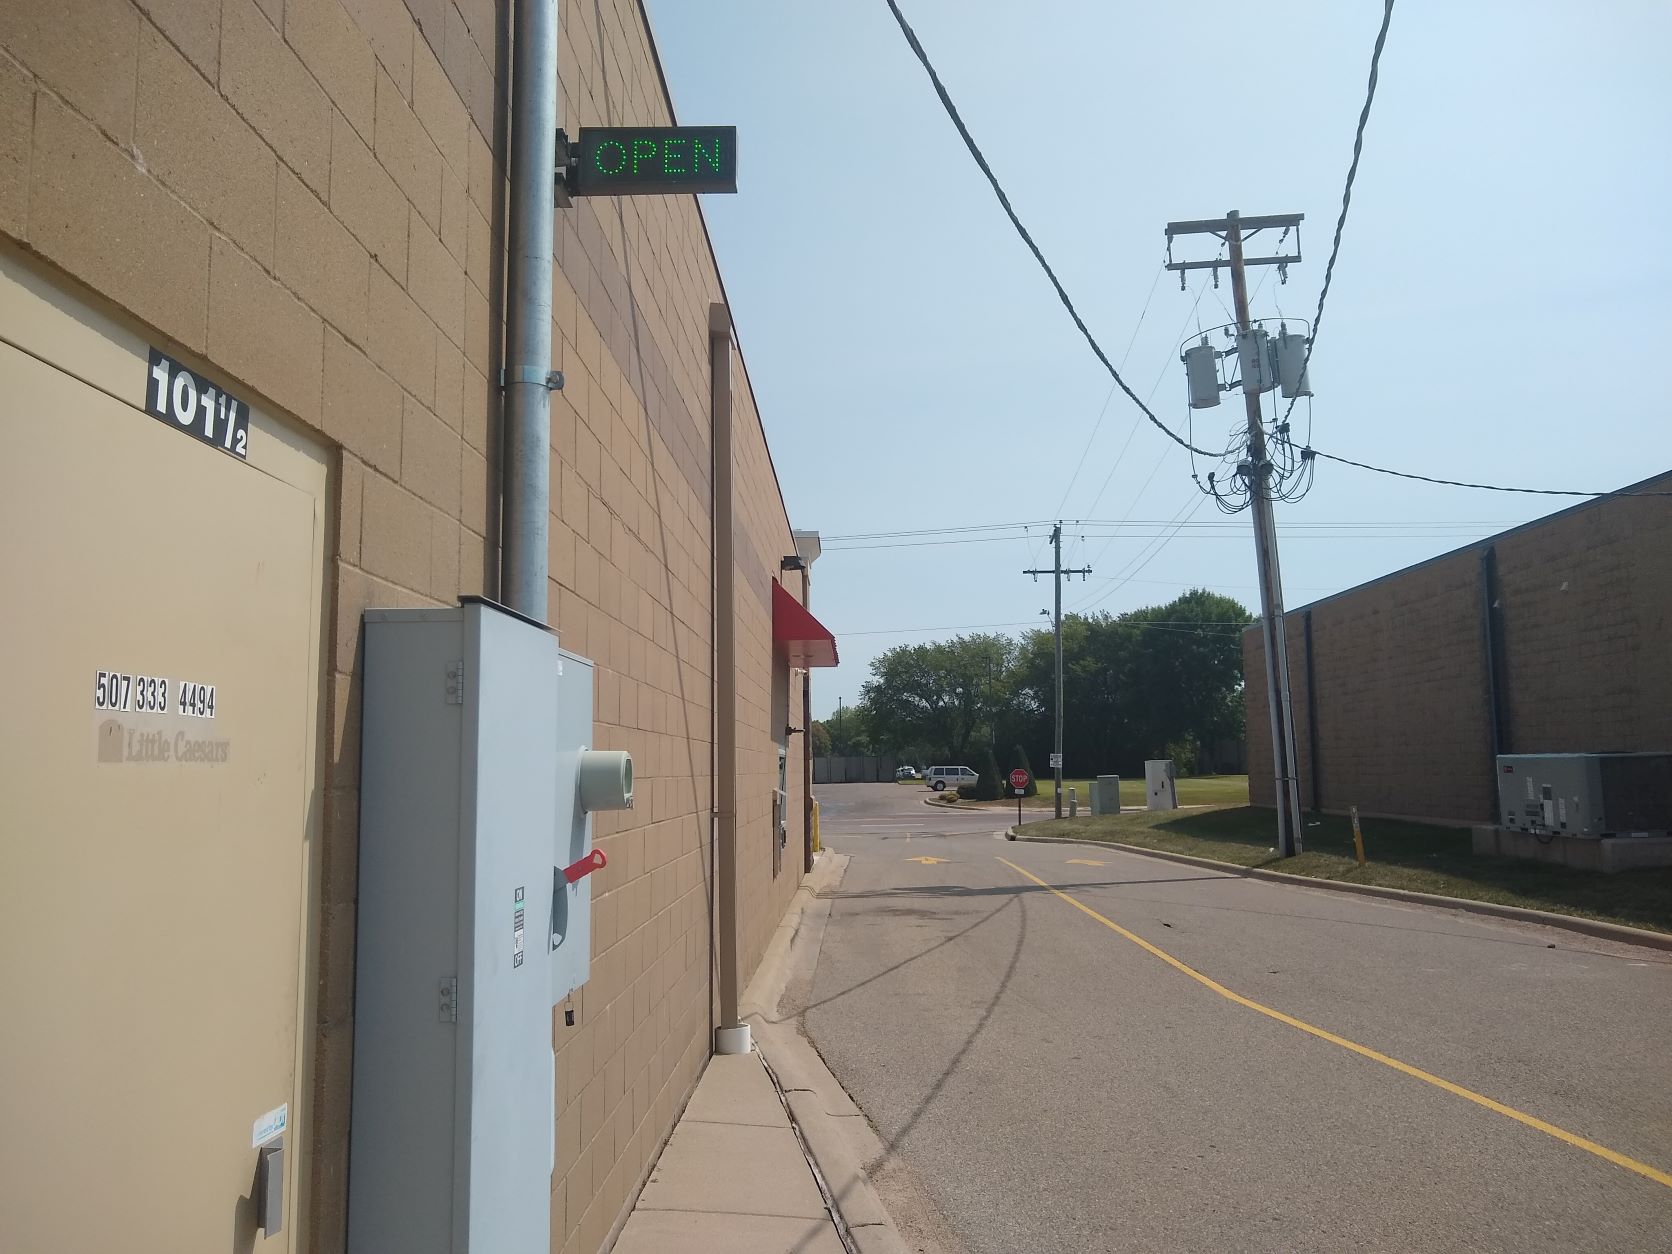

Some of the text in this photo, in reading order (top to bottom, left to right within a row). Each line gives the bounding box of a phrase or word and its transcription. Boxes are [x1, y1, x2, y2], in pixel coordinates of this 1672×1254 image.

[595, 138, 721, 175] OPEN
[96, 672, 214, 717] 507 333 4494
[126, 728, 230, 763] Little Caesars
[1011, 774, 1028, 783] STOP
